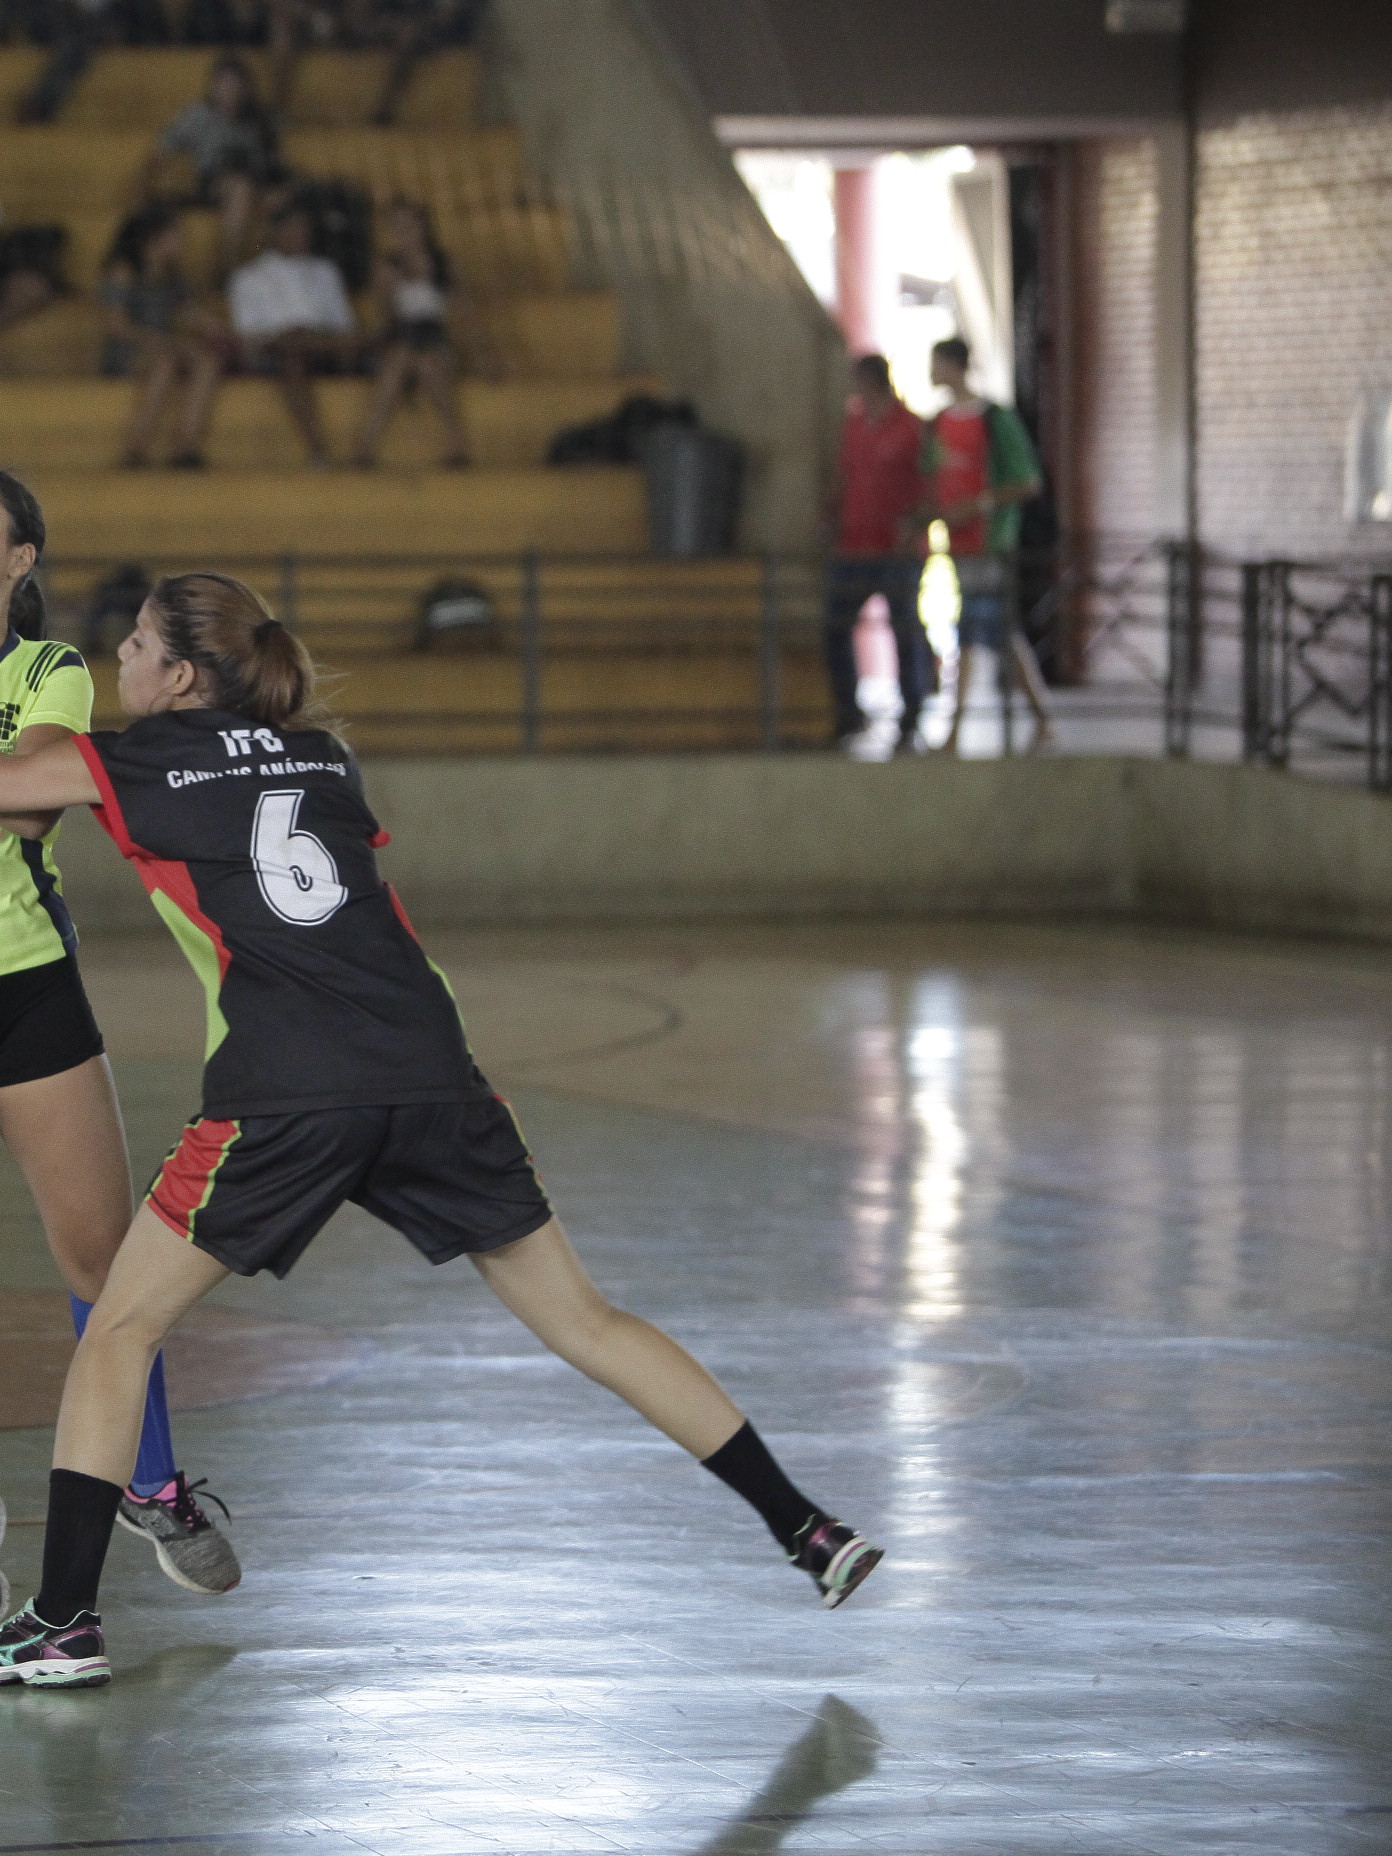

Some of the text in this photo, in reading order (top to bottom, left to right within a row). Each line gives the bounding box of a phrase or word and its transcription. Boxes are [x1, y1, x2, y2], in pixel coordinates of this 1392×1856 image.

[217, 727, 285, 757] IFG
[166, 766, 253, 789] CAMS
[250, 789, 348, 926] 6
